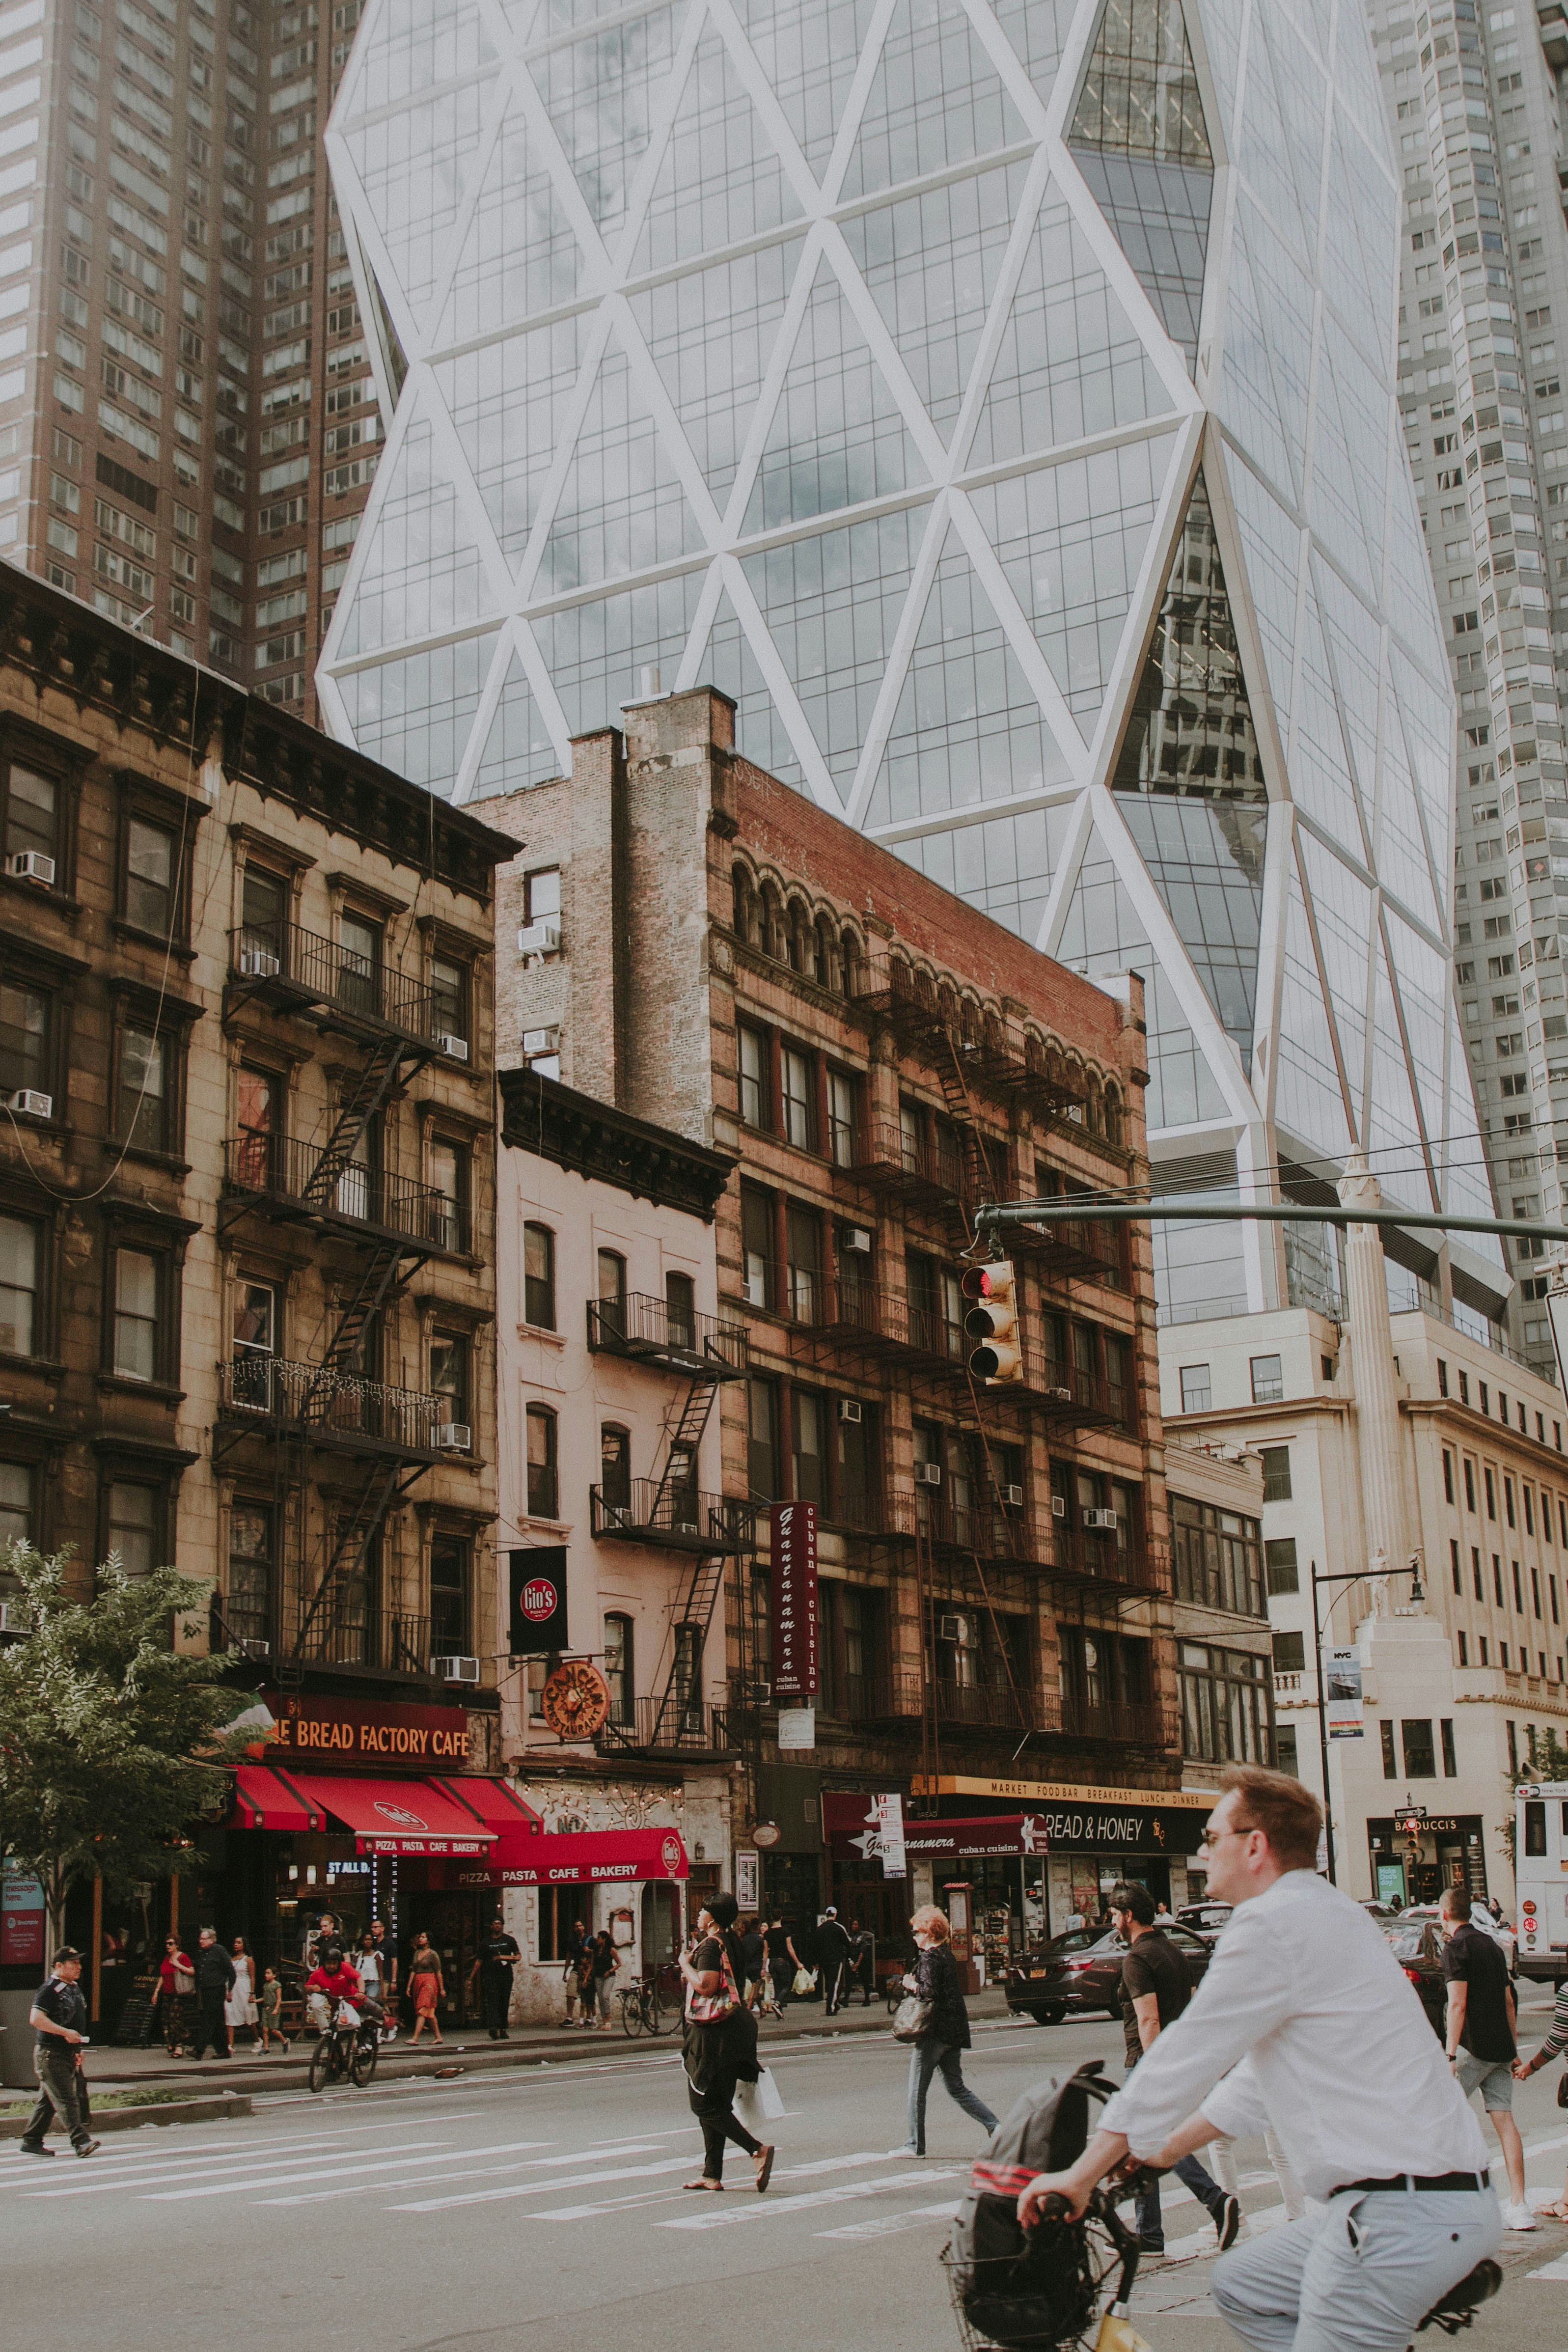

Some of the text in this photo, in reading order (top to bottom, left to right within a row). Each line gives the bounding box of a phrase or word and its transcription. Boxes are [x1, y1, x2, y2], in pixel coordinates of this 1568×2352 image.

[524, 1586, 553, 1609] Gio's
[779, 1507, 795, 1670] Guantanamera
[546, 1666, 604, 1704] CANCUN
[297, 1720, 354, 1749] BREAD
[360, 1725, 428, 1754] FACTORY
[432, 1730, 469, 1756] CAFE
[991, 1782, 1026, 1795] MARKET
[1088, 1789, 1131, 1801] BREAKFAST
[1141, 1793, 1165, 1803] LUNCH
[1173, 1796, 1199, 1805] DINNER
[1037, 1814, 1143, 1841] READ & HONEY
[1395, 1820, 1457, 1831] BADUCCI'S
[376, 1841, 479, 1852] PIZZA PASTA CAFE BAKERY
[866, 1836, 956, 1855] Guanamera
[987, 1844, 1018, 1853] cuisine
[459, 1865, 638, 1882] PIZZA PASTA CAFE BAKERY
